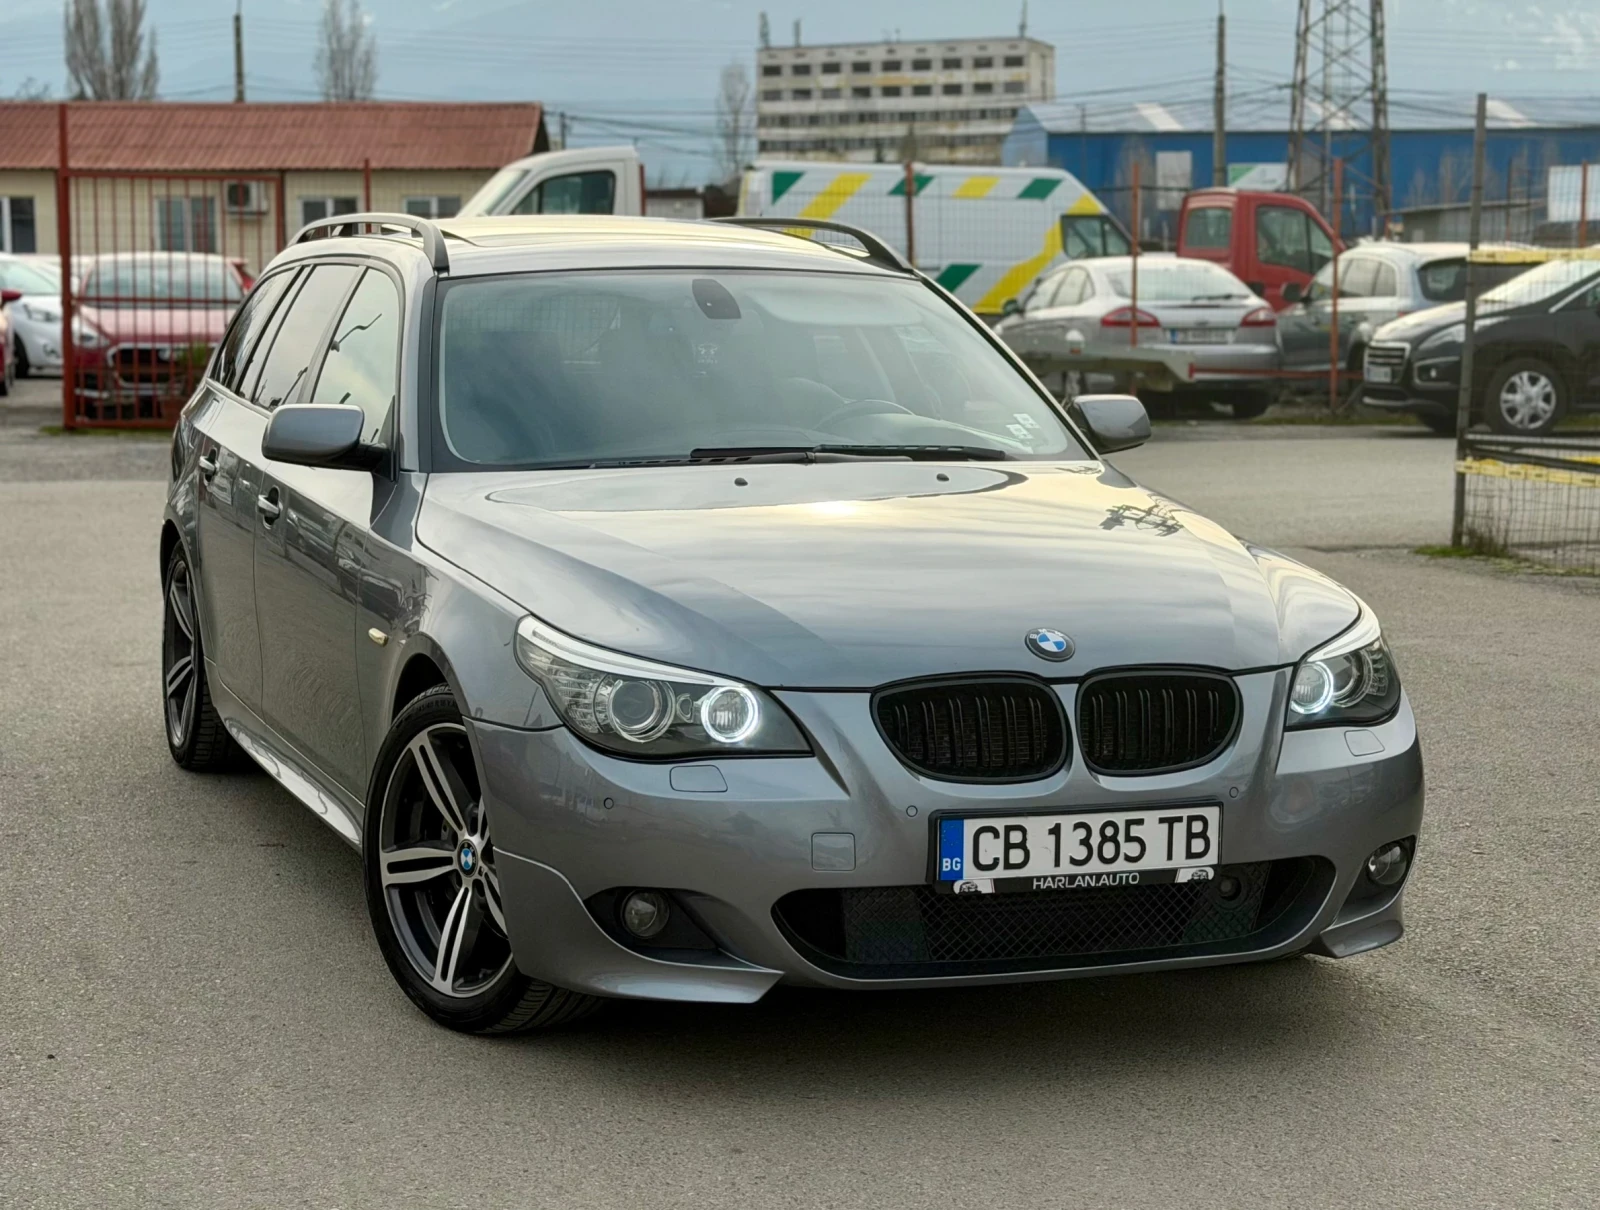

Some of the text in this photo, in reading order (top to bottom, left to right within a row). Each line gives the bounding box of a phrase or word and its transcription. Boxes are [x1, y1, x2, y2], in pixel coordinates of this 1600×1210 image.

[972, 815, 1211, 871] CB 1385 TB
[942, 857, 961, 871] BG
[1032, 873, 1140, 889] HARLAN.AUTO
